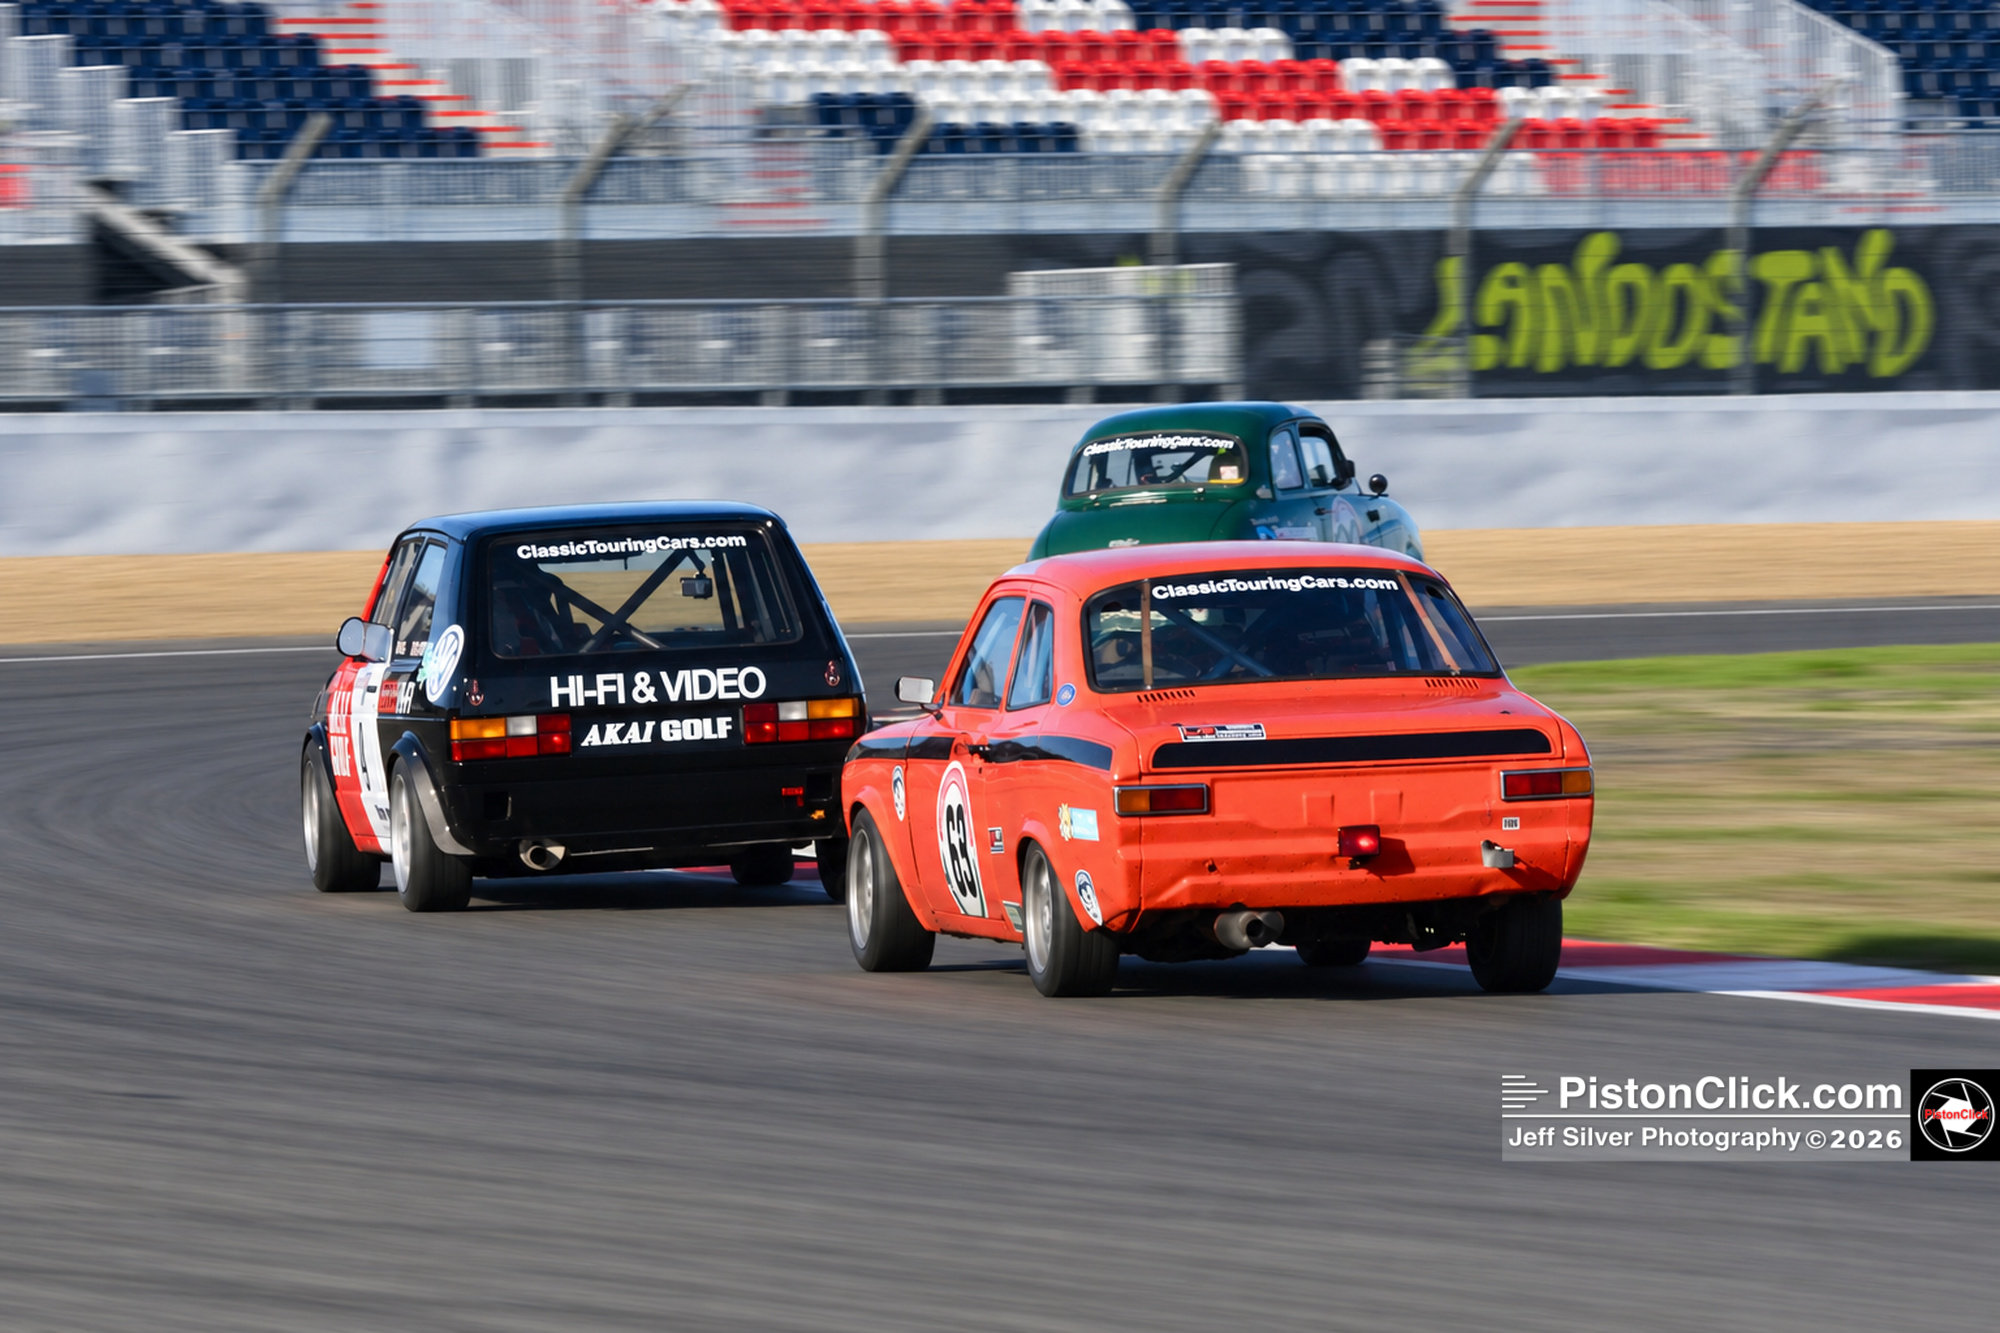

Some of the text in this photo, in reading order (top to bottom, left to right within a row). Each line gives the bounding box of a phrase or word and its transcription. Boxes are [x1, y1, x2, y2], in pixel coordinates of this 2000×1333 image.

[1083, 434, 1235, 456] ClassicTouringCars.com
[517, 536, 747, 559] ClassicTouringCars.com
[1152, 575, 1399, 600] ClassicTouringCars.com
[550, 666, 767, 707] HI-FI & VIDEO
[581, 717, 733, 747] AKAI GOLF
[946, 803, 978, 898] 63
